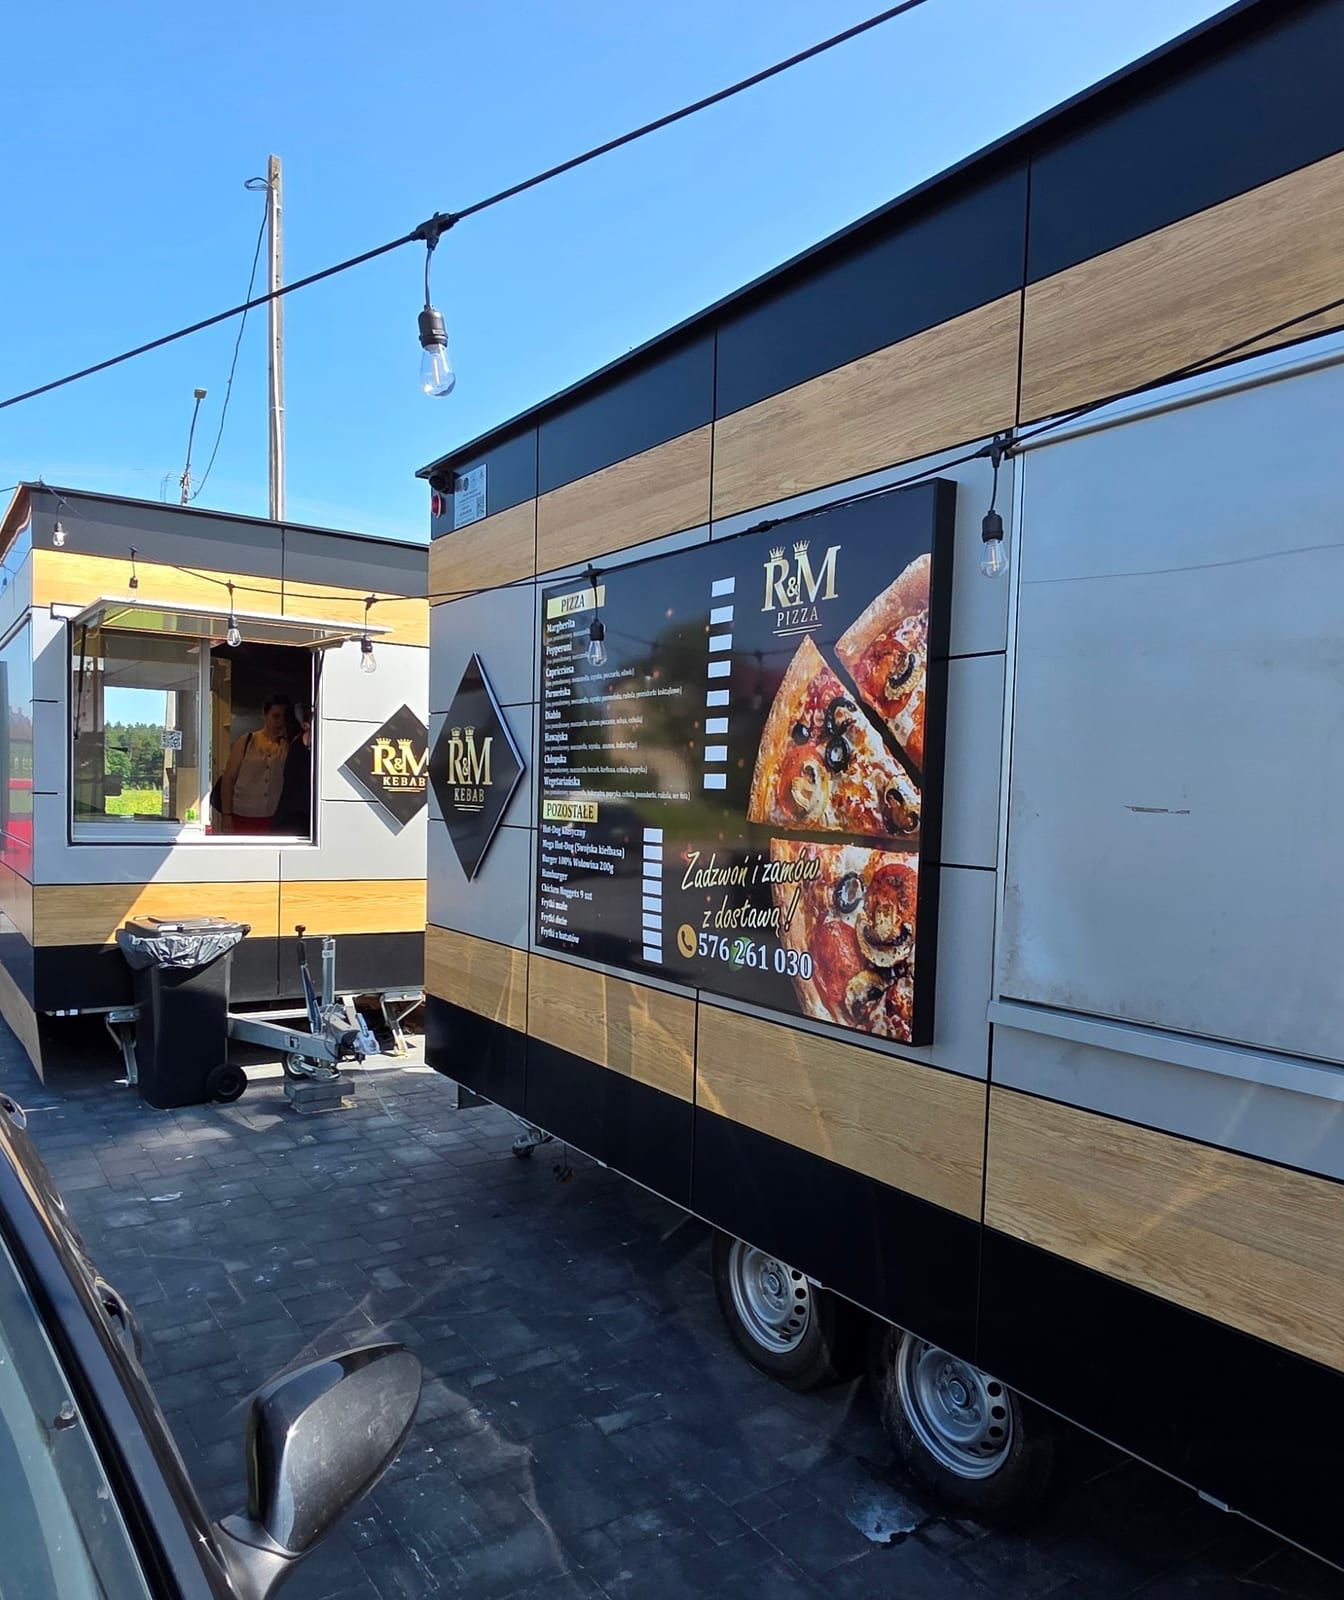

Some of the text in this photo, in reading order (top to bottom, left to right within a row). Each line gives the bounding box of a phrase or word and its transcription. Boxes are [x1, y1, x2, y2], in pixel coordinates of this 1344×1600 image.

[761, 544, 841, 611] R&M
[561, 594, 585, 612] PIZZA
[777, 606, 818, 627] PIZZA
[546, 619, 576, 634] Margherita
[447, 737, 493, 785] R&M
[383, 776, 426, 787] KEBAB
[454, 788, 485, 802] KEBAB
[547, 803, 594, 819] POZOSTAŁE
[542, 840, 625, 859] Mega Hot-Dog (Swojska kiełbasa)
[542, 854, 558, 865] Burger
[558, 855, 573, 867] 100%
[599, 861, 614, 875] 200g
[681, 847, 820, 890] Zadzwoń i zamów
[541, 883, 559, 894] Chicken
[560, 886, 580, 899] Nuggets
[580, 889, 584, 899] 9
[541, 897, 555, 909] Frytki
[541, 911, 555, 923] Frytki
[702, 911, 711, 928] z
[540, 926, 555, 938] Frytki
[698, 932, 813, 980] 576 261 030
